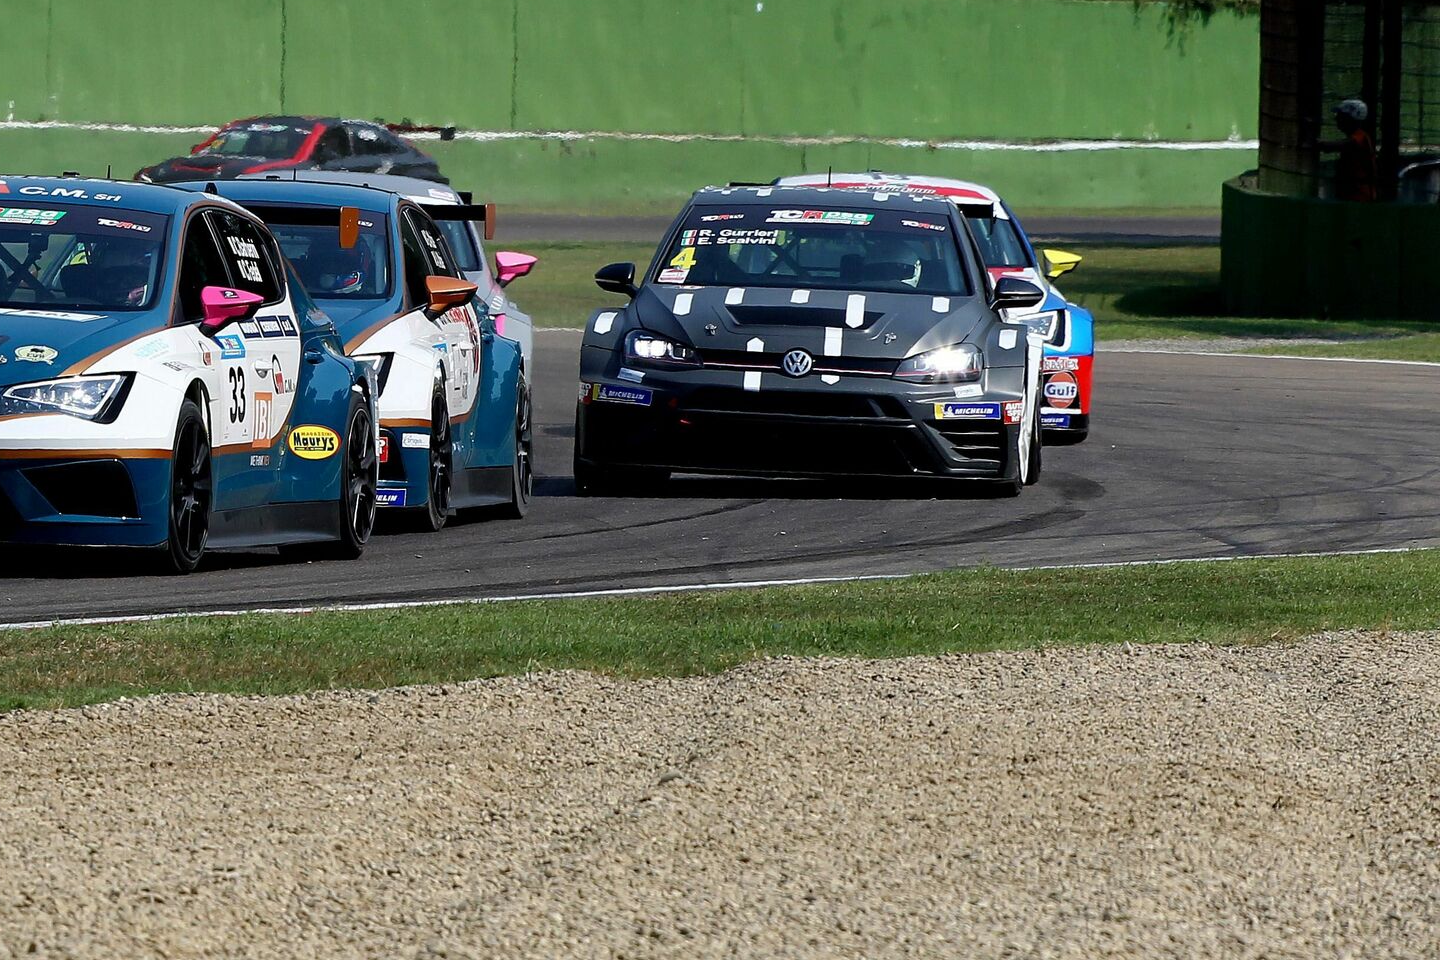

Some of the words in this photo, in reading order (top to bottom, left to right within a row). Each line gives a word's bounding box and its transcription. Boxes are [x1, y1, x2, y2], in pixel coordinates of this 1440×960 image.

[19, 186, 89, 199] C.M.
[94, 193, 122, 202] Srl
[770, 209, 824, 219] TCR
[699, 229, 715, 237] R.
[719, 229, 779, 238] Gurrieri
[697, 237, 712, 245] E.
[716, 237, 777, 245] Scalvini
[670, 246, 697, 269] 4
[783, 350, 813, 377] VW
[228, 366, 246, 424] 33
[608, 390, 645, 400] MICHELIN
[1046, 384, 1076, 396] Gulf
[954, 407, 994, 415] MICHELIN
[254, 399, 272, 440] IBI
[293, 431, 335, 451] Maurys
